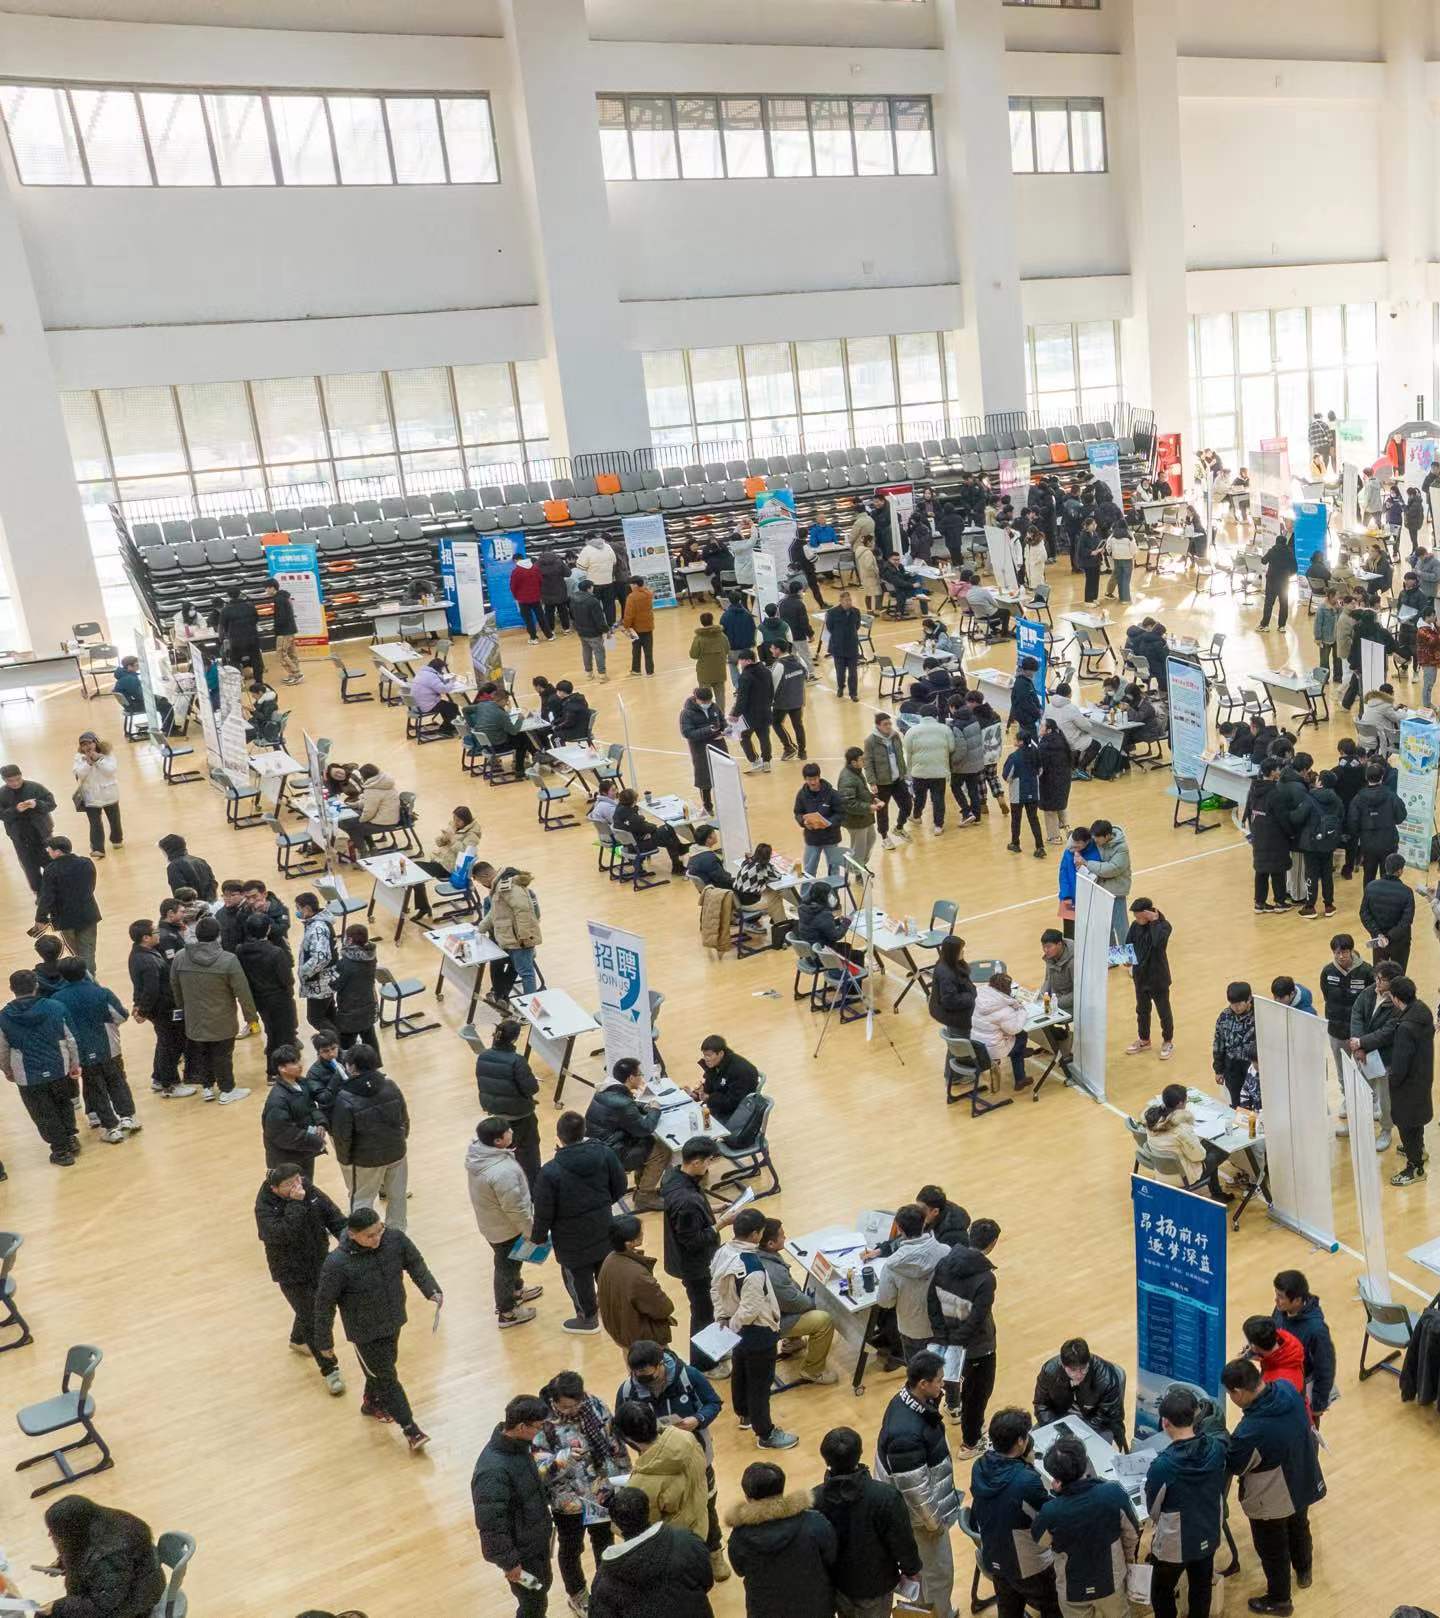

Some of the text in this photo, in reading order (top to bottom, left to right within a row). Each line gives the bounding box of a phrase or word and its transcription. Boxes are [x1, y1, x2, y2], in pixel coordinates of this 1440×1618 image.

[594, 941, 637, 980] 招聘
[598, 973, 629, 992] JOIN US
[1140, 1212, 1208, 1250] 昂扬前行
[1147, 1236, 1214, 1275] 逐梦深蓝
